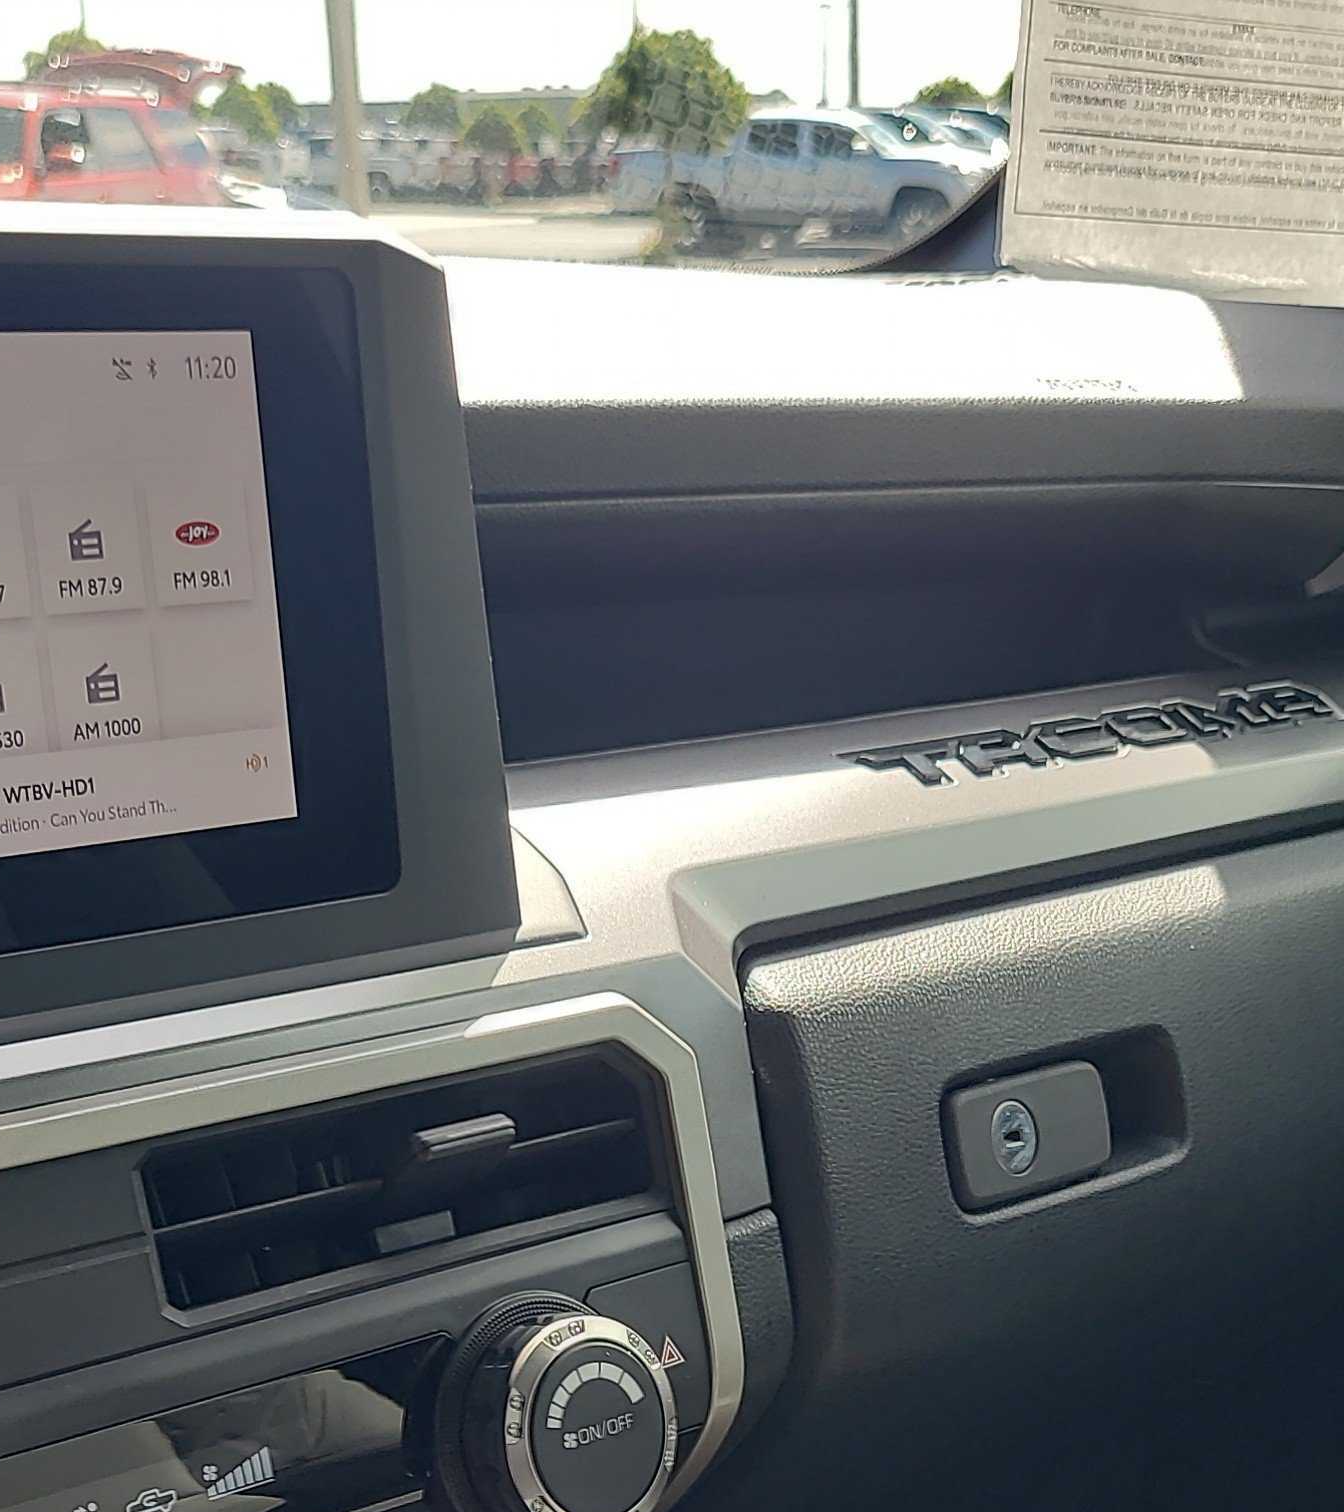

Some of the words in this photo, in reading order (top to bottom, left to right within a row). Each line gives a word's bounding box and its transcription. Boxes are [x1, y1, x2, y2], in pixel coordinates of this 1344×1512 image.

[184, 356, 237, 381] 11:20
[59, 580, 84, 598] FM
[88, 577, 123, 596] 87.9
[173, 572, 197, 590] FM
[200, 569, 232, 588] 98.1
[73, 722, 101, 741] AM
[105, 717, 142, 737] 1000
[2, 776, 96, 804] WTBV-HD1
[50, 813, 78, 829] Can
[79, 807, 106, 824] You
[108, 804, 146, 821] Stand
[577, 1412, 635, 1446] ON/OFF
